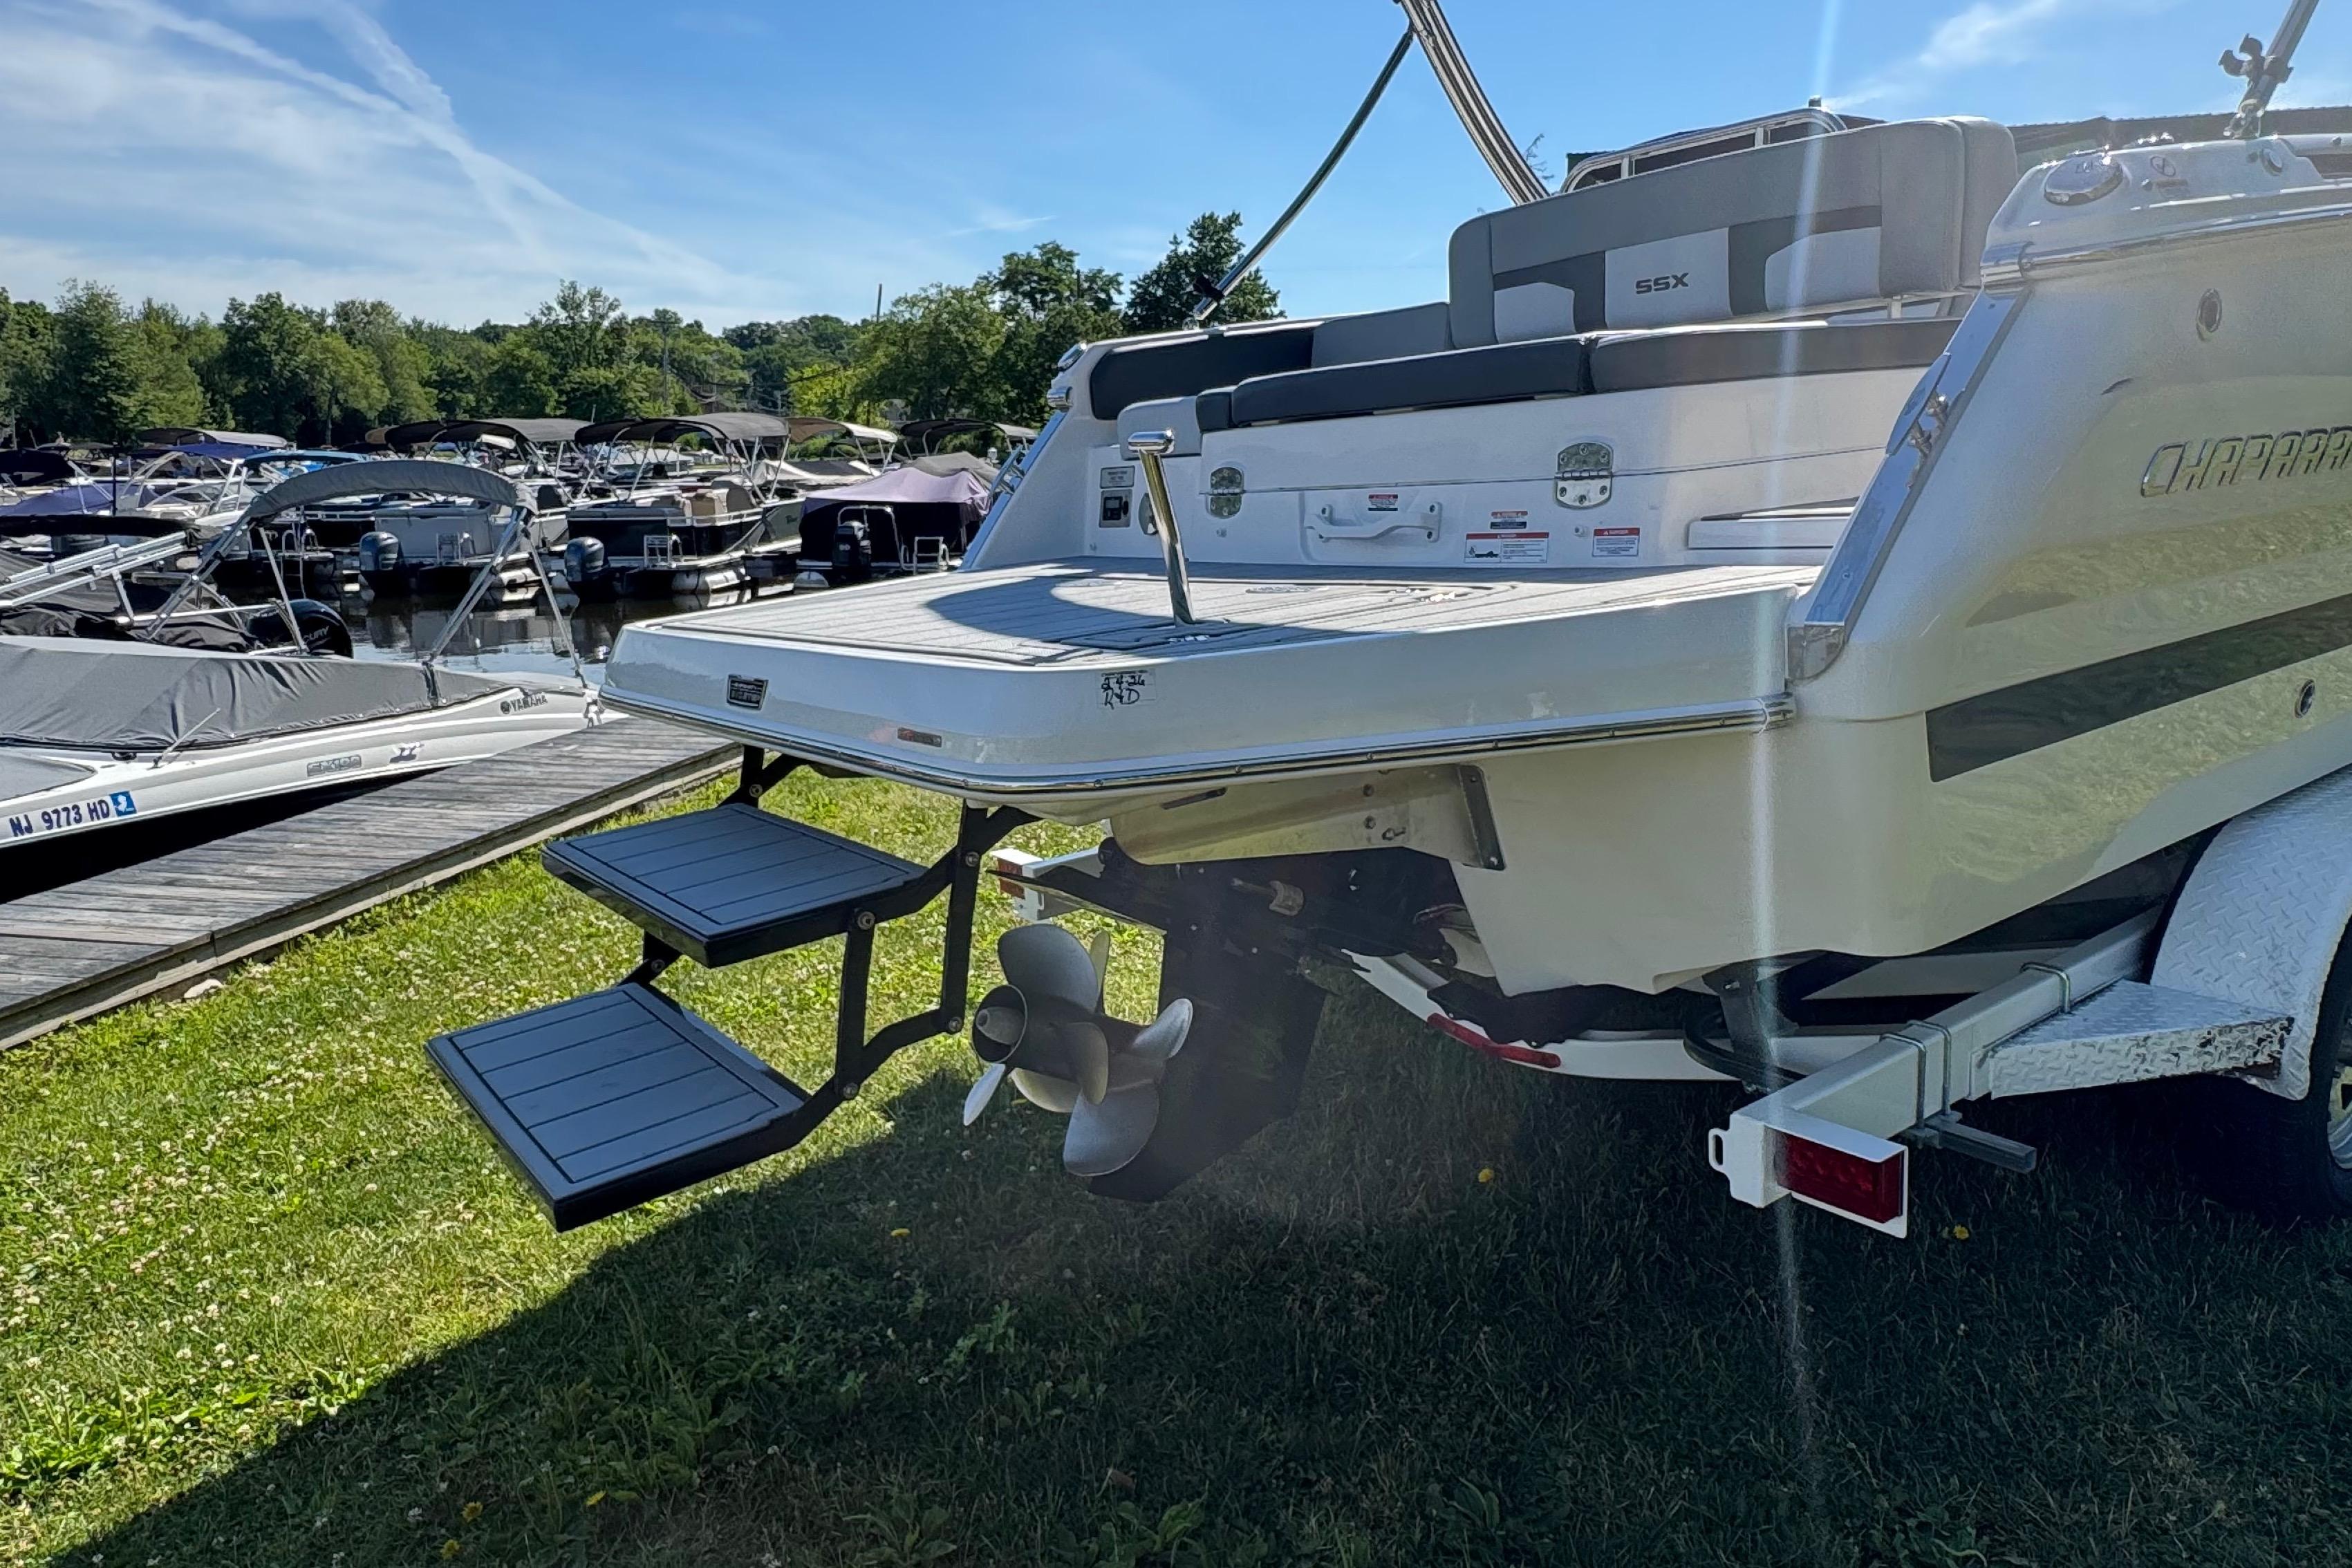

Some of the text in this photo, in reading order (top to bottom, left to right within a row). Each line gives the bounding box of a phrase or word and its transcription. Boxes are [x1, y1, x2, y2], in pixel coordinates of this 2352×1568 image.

[1636, 272, 1688, 294] SSX
[2140, 426, 2352, 497] CHAPARR
[510, 695, 548, 711] YAMAHA
[9, 799, 110, 837] NJ 9773 HD
